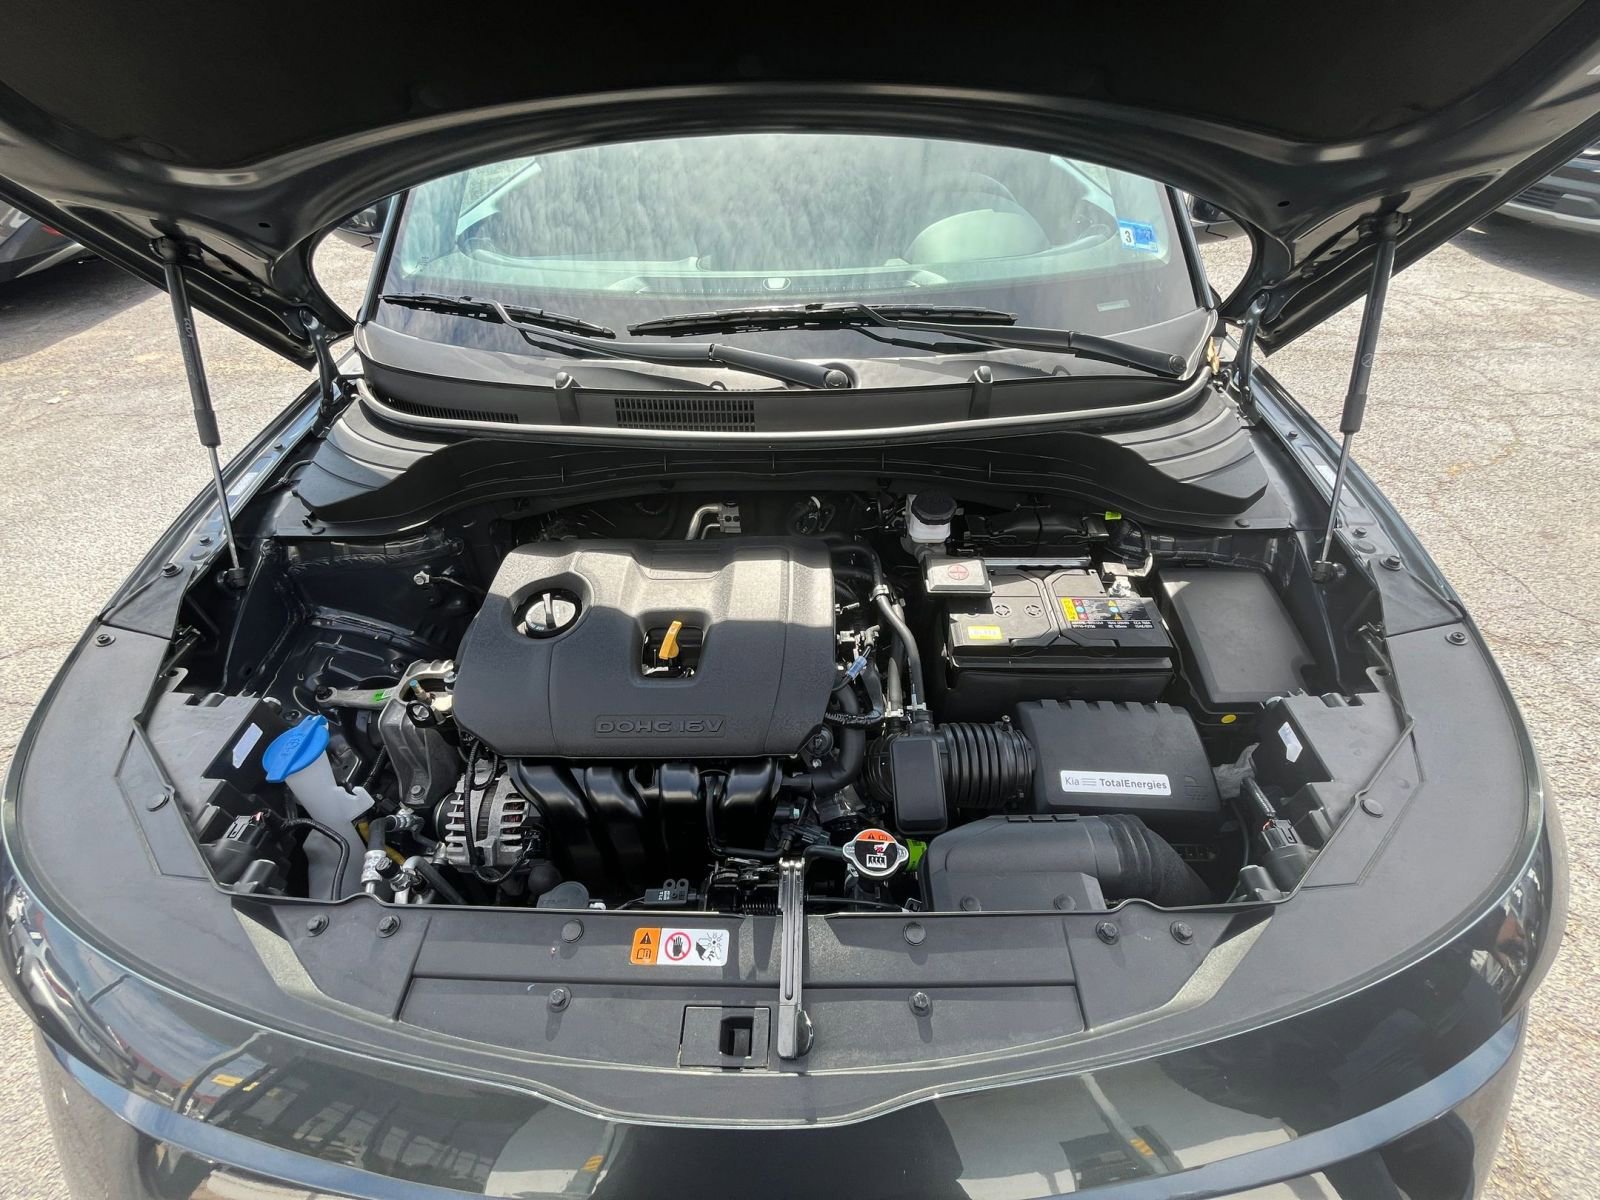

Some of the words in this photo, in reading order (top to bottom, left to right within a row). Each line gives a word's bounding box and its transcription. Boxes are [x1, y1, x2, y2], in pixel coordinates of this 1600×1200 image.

[1124, 230, 1132, 243] 3
[597, 719, 673, 733] DOHC
[679, 719, 724, 733] 16V
[1064, 776, 1080, 786] Kia
[1099, 778, 1168, 790] TotalEnergies
